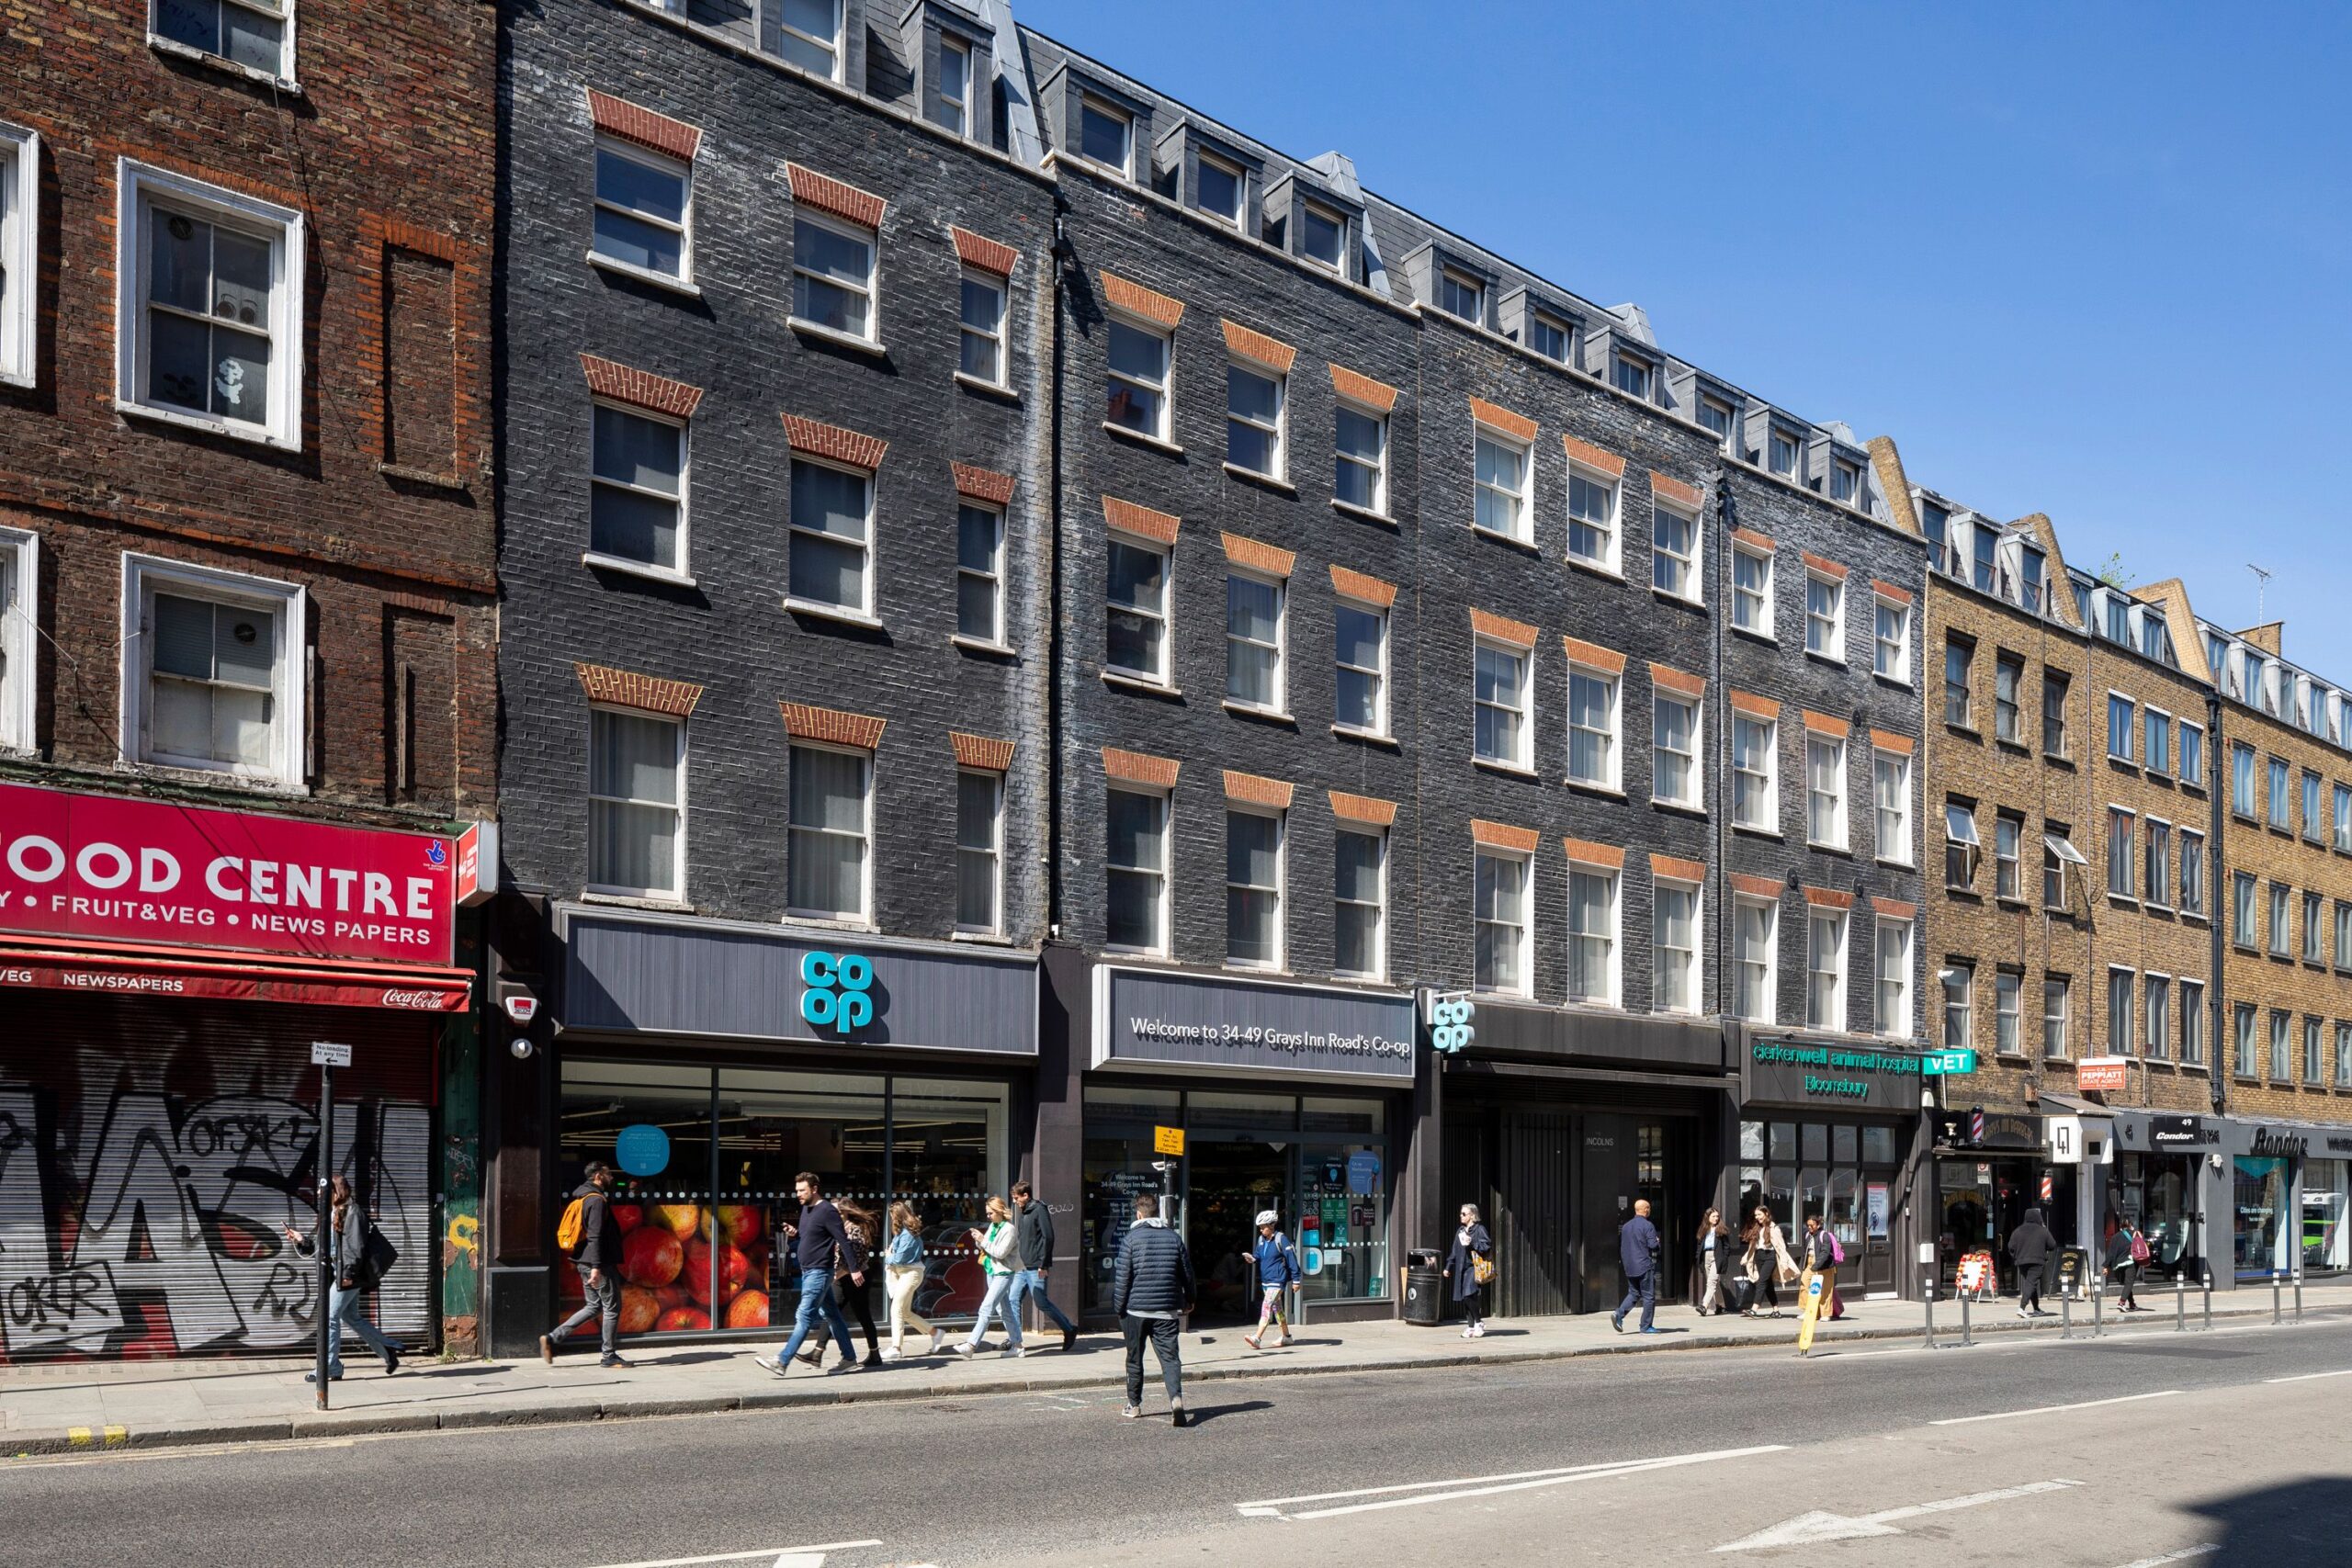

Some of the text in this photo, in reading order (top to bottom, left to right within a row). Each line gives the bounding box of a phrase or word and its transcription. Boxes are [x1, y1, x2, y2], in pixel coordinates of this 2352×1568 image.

[0, 834, 181, 893] OOD
[205, 855, 434, 919] CENTRE
[51, 895, 216, 926] FRUIT&VEG
[252, 913, 325, 936] NEWS
[334, 920, 432, 946] PAPERS
[63, 973, 184, 992] NEWSPAPERS
[382, 988, 445, 1010] Coca-Cola
[326, 1045, 349, 1054] loading
[1131, 1017, 1410, 1056] Welcome to 34-49 Grays Inn Road's Co-op
[1753, 1043, 1919, 1074] clerkenwell animal hospital
[1930, 1053, 1968, 1071] VET
[1805, 1075, 1868, 1097] Bloomsbury
[2081, 1071, 2123, 1079] PEPPIATT
